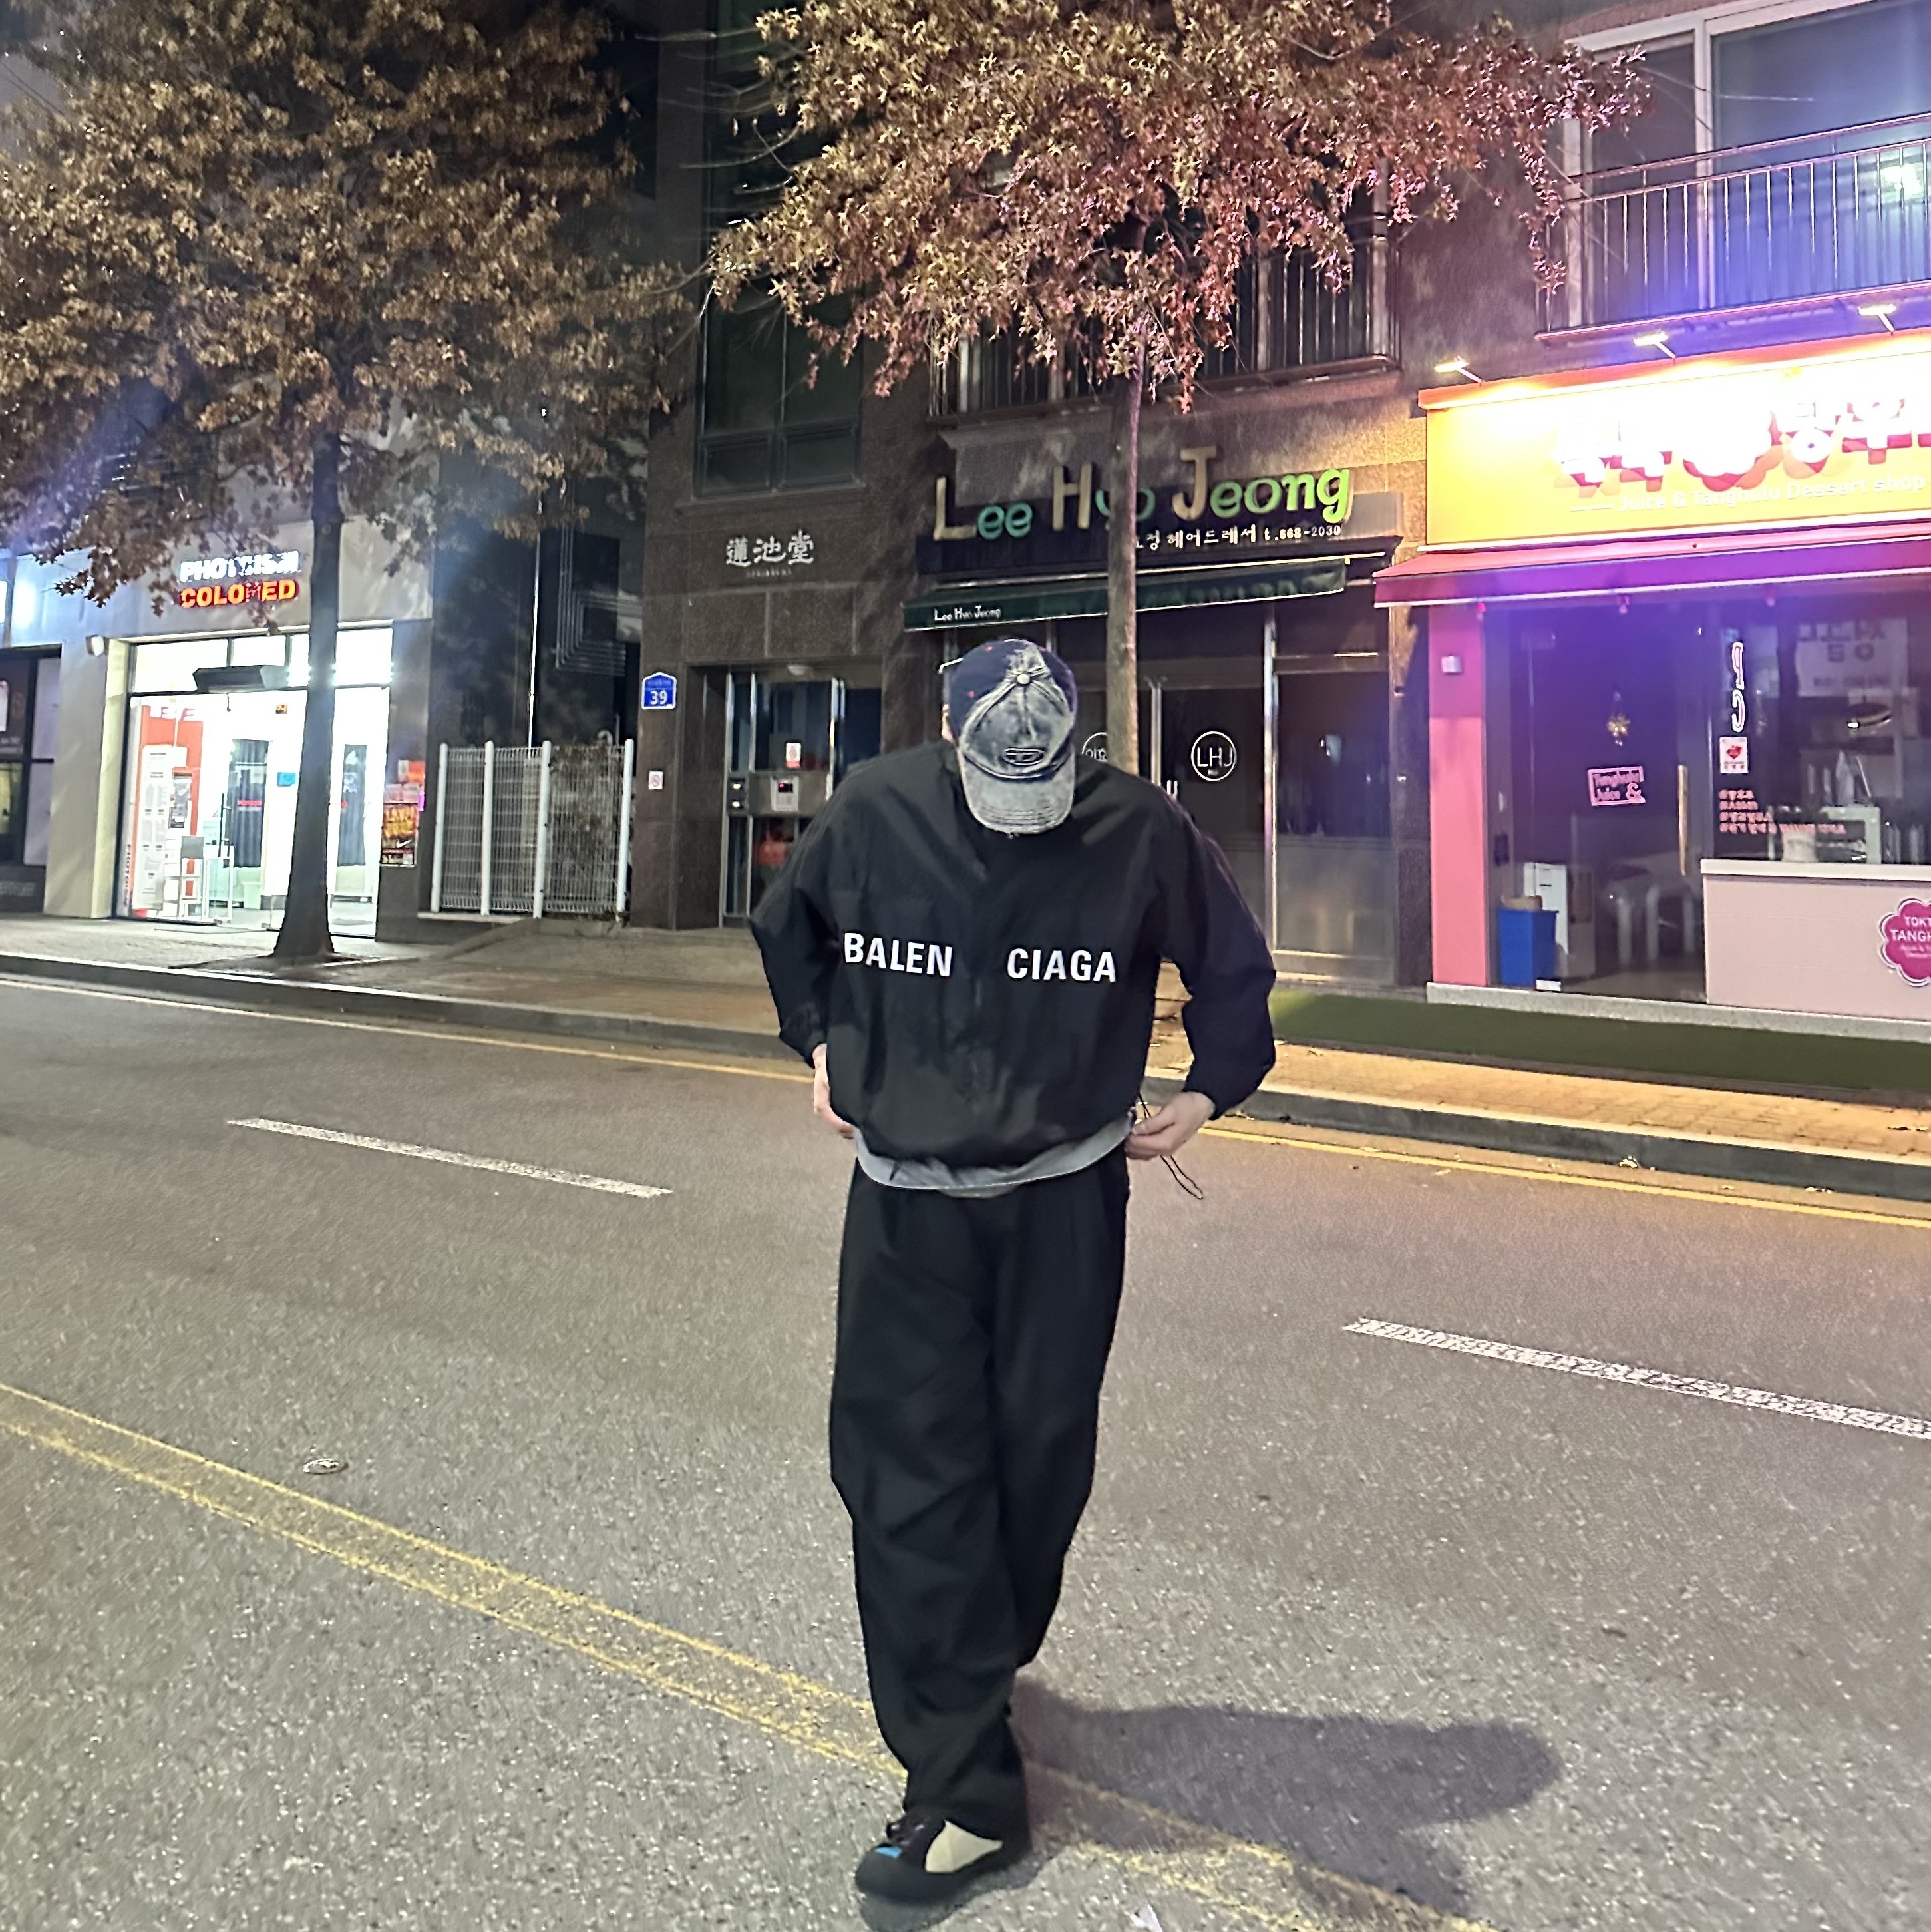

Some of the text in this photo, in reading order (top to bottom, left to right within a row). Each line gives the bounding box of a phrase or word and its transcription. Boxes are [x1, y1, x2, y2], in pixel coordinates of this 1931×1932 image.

[934, 477, 1033, 541] Lee
[1172, 446, 1352, 524] Jeong
[1618, 473, 1925, 512] Juice & Tanghulu Dessert shop
[1167, 524, 1256, 549] 헤어드레서
[650, 689, 668, 705] 39
[1197, 747, 1233, 767] LHJ
[843, 932, 1117, 982] BALEN CIAGA
